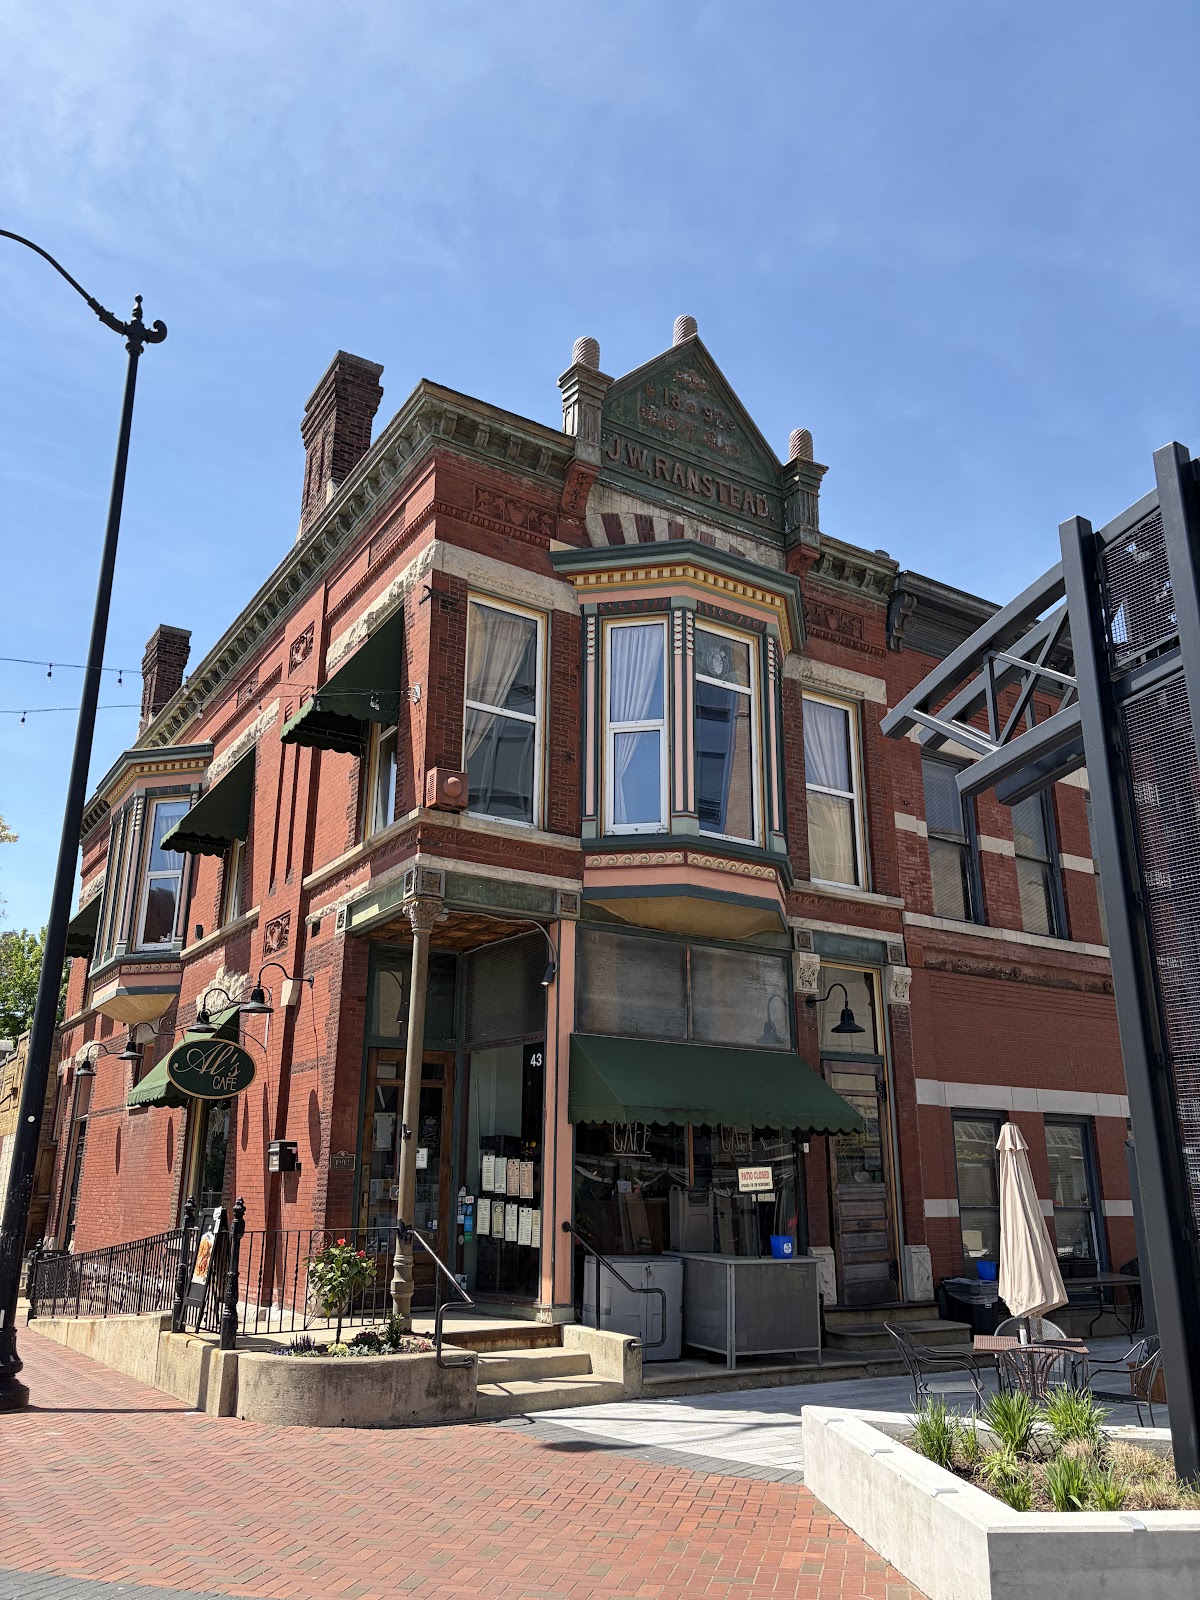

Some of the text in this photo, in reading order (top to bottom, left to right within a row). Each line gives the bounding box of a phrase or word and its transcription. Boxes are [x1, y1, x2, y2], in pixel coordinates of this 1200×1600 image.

[173, 1042, 241, 1076] Al's
[530, 1053, 542, 1067] 43
[212, 1076, 238, 1091] CAFE
[741, 1170, 770, 1181] PATIO CLOSED
